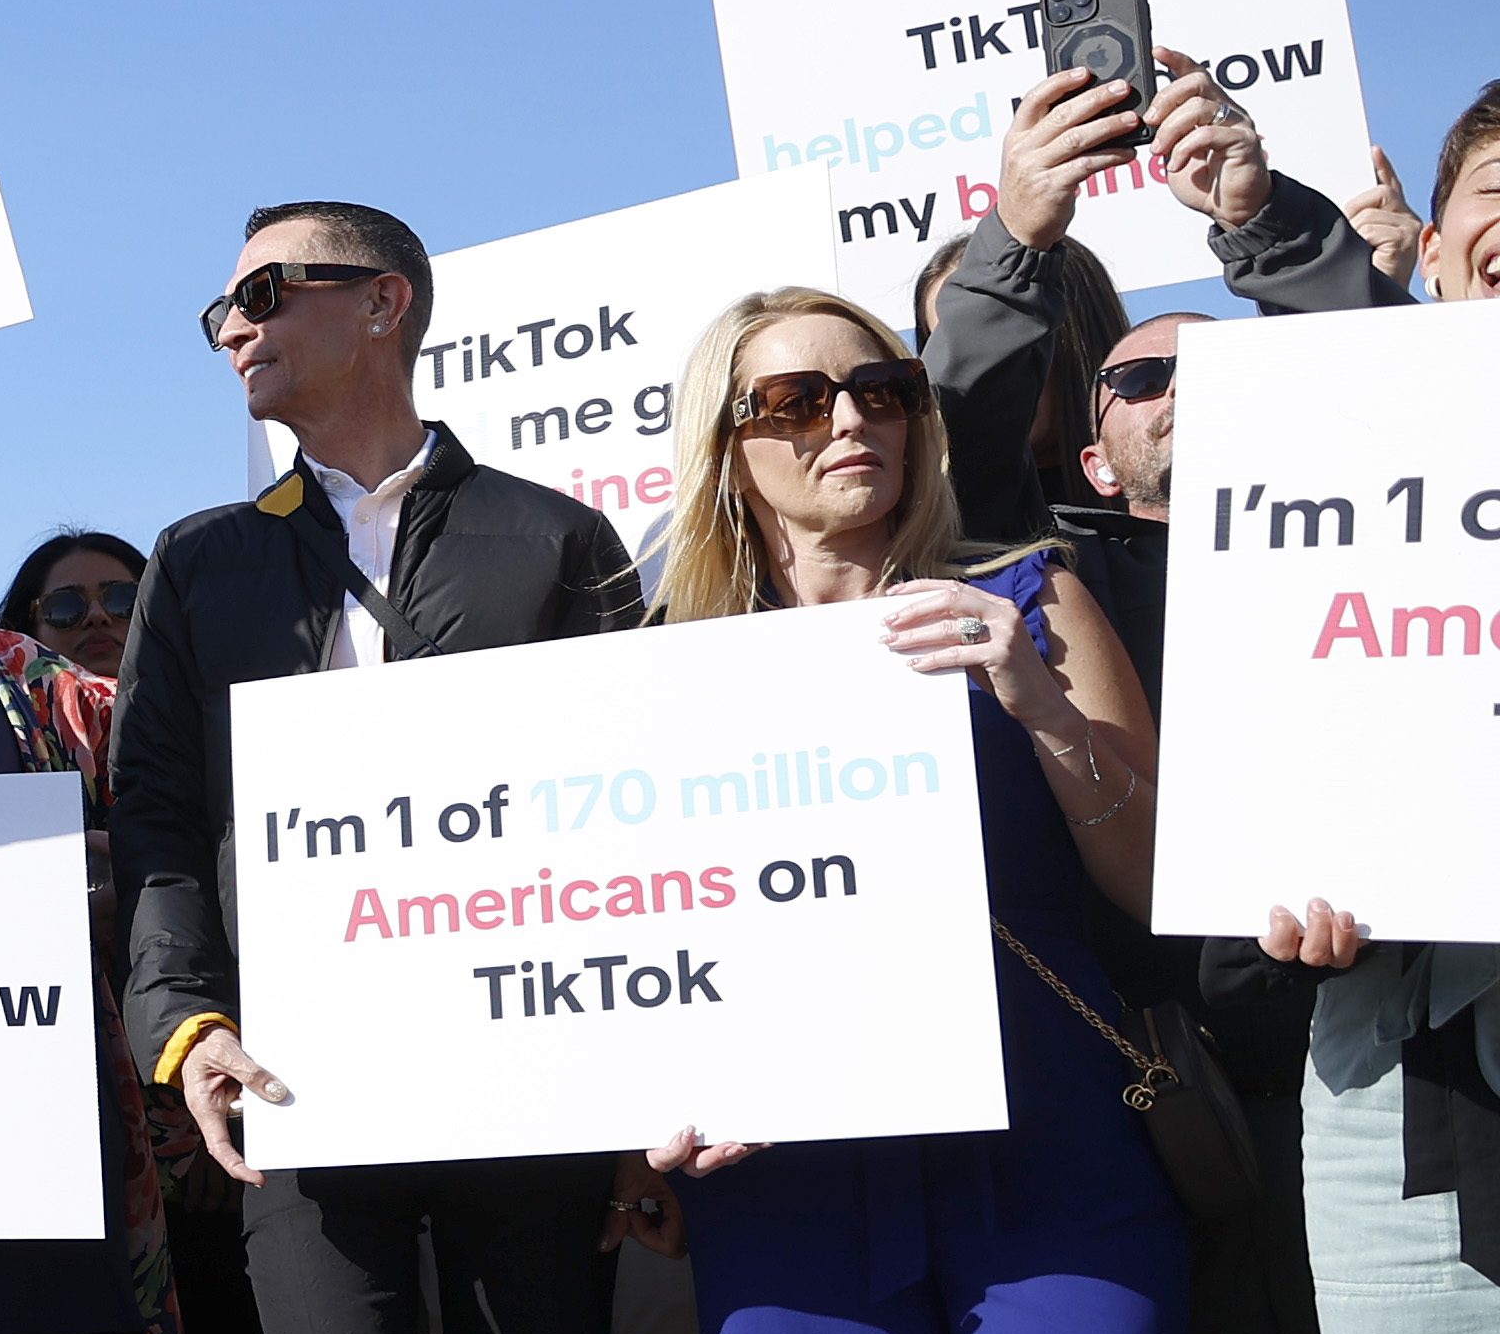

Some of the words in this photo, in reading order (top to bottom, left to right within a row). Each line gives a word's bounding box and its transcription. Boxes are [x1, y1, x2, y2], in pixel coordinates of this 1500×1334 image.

[907, 3, 1041, 70] TikT
[764, 92, 992, 173] helped
[839, 193, 936, 243] my
[420, 305, 638, 390] TikTok
[511, 398, 613, 450] me
[1387, 477, 1424, 543] 1
[386, 796, 412, 848] 1
[438, 784, 509, 843] of
[531, 769, 657, 832] 170
[681, 746, 940, 818] million
[344, 866, 736, 942] Americans
[759, 855, 857, 902] on
[473, 950, 722, 1020] TikTok
